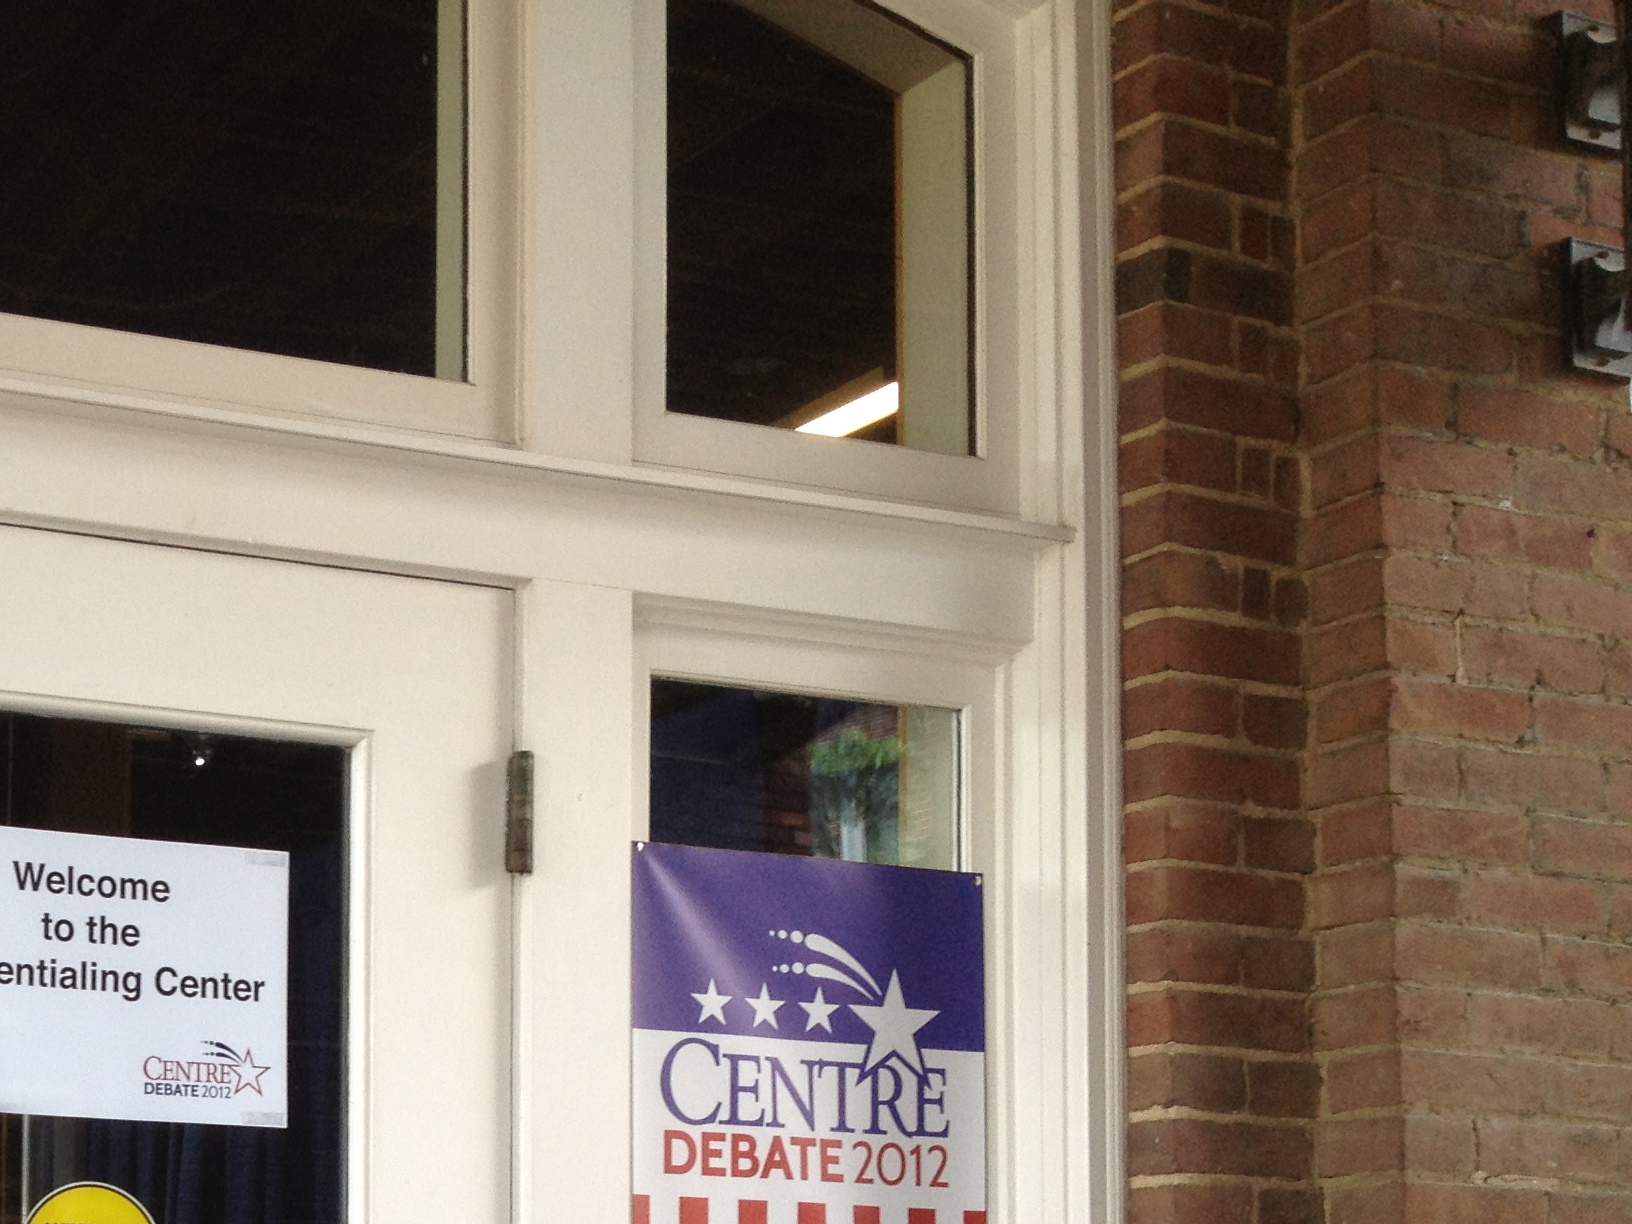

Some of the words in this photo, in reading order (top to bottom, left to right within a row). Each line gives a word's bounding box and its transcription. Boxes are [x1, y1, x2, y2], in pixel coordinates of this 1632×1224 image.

[13, 860, 171, 903] Welcome
[41, 912, 74, 943] to
[86, 915, 140, 947] the
[155, 966, 266, 1002] Center
[143, 1055, 233, 1084] CENTRE
[144, 1082, 199, 1098] DEBATE
[201, 1085, 232, 1099] 2012
[660, 1037, 950, 1139] CENTRE
[663, 1129, 845, 1183] DEBATE
[853, 1140, 950, 1188] 2012
